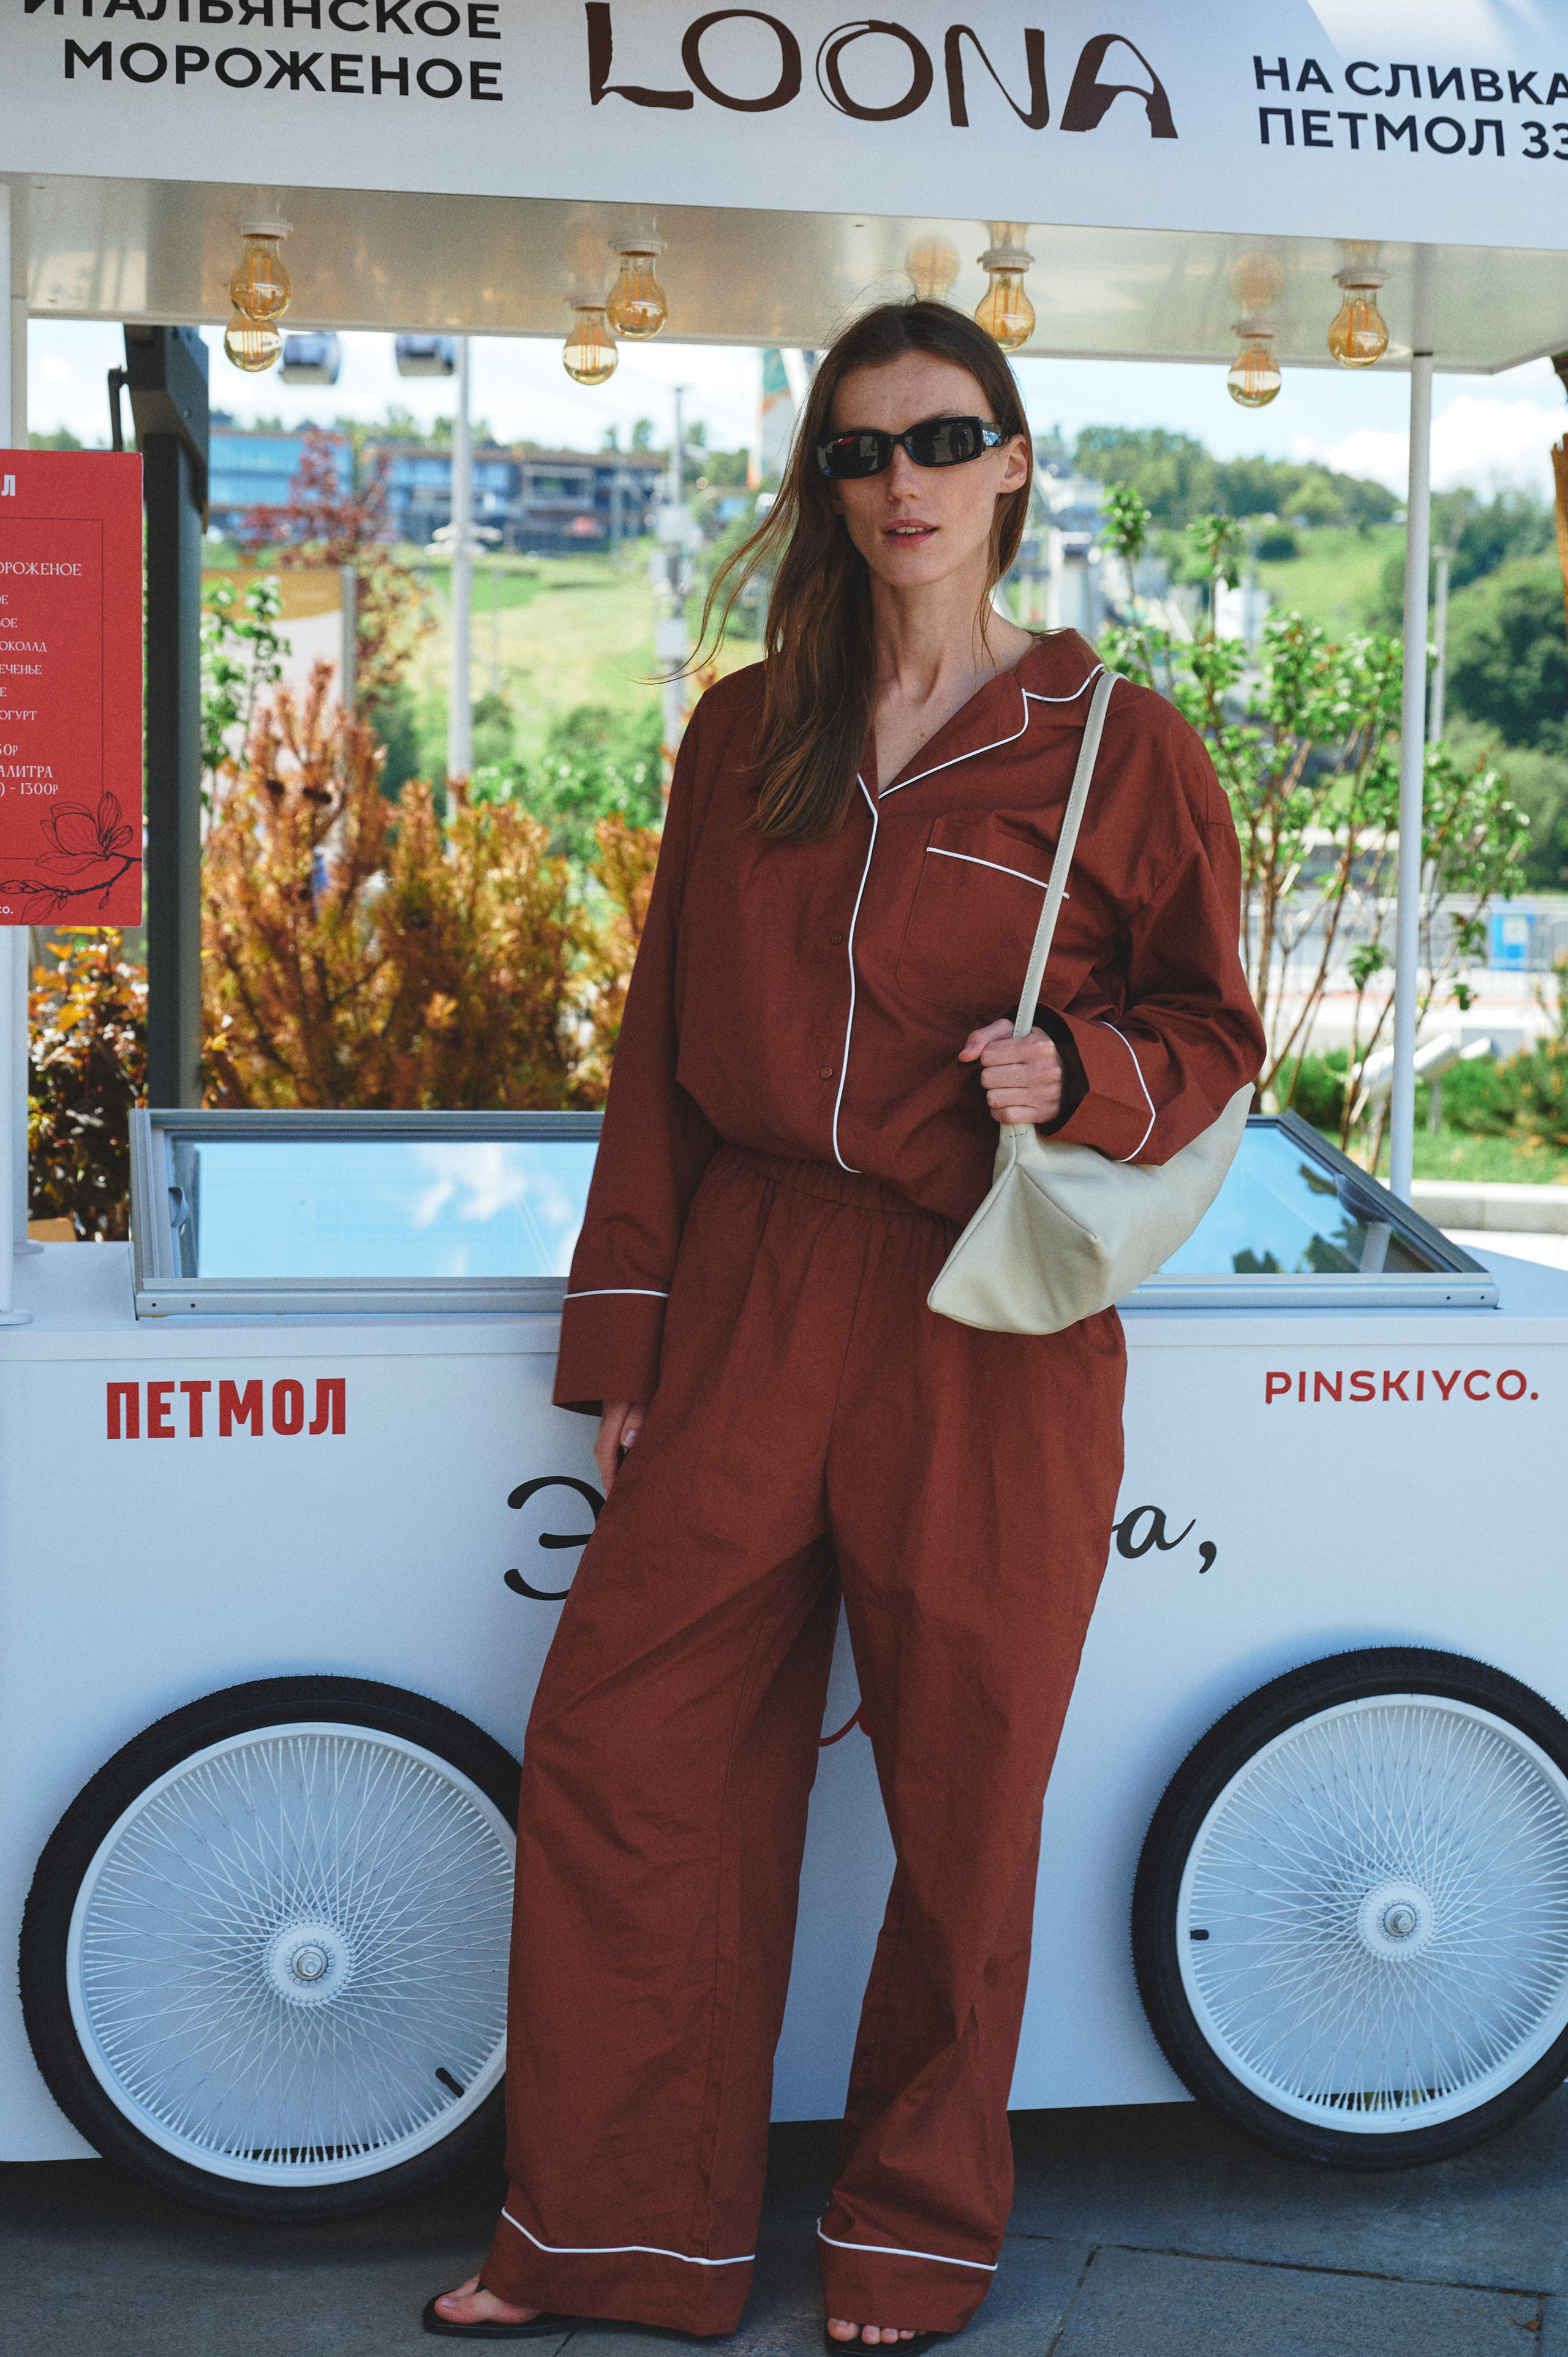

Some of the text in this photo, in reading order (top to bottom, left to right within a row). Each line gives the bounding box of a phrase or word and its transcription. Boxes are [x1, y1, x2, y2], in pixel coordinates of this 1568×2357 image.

[64, 39, 503, 101] МОРОЖЕНОЕ
[585, 2, 1178, 138] LOONA
[1254, 56, 1333, 92] НА
[1259, 108, 1504, 156] ПЕТМОЛ
[0, 617, 18, 628] ОЕ
[107, 1379, 345, 1439] ПЕТМОЛ
[1266, 1370, 1537, 1404] PINSKIYCO.
